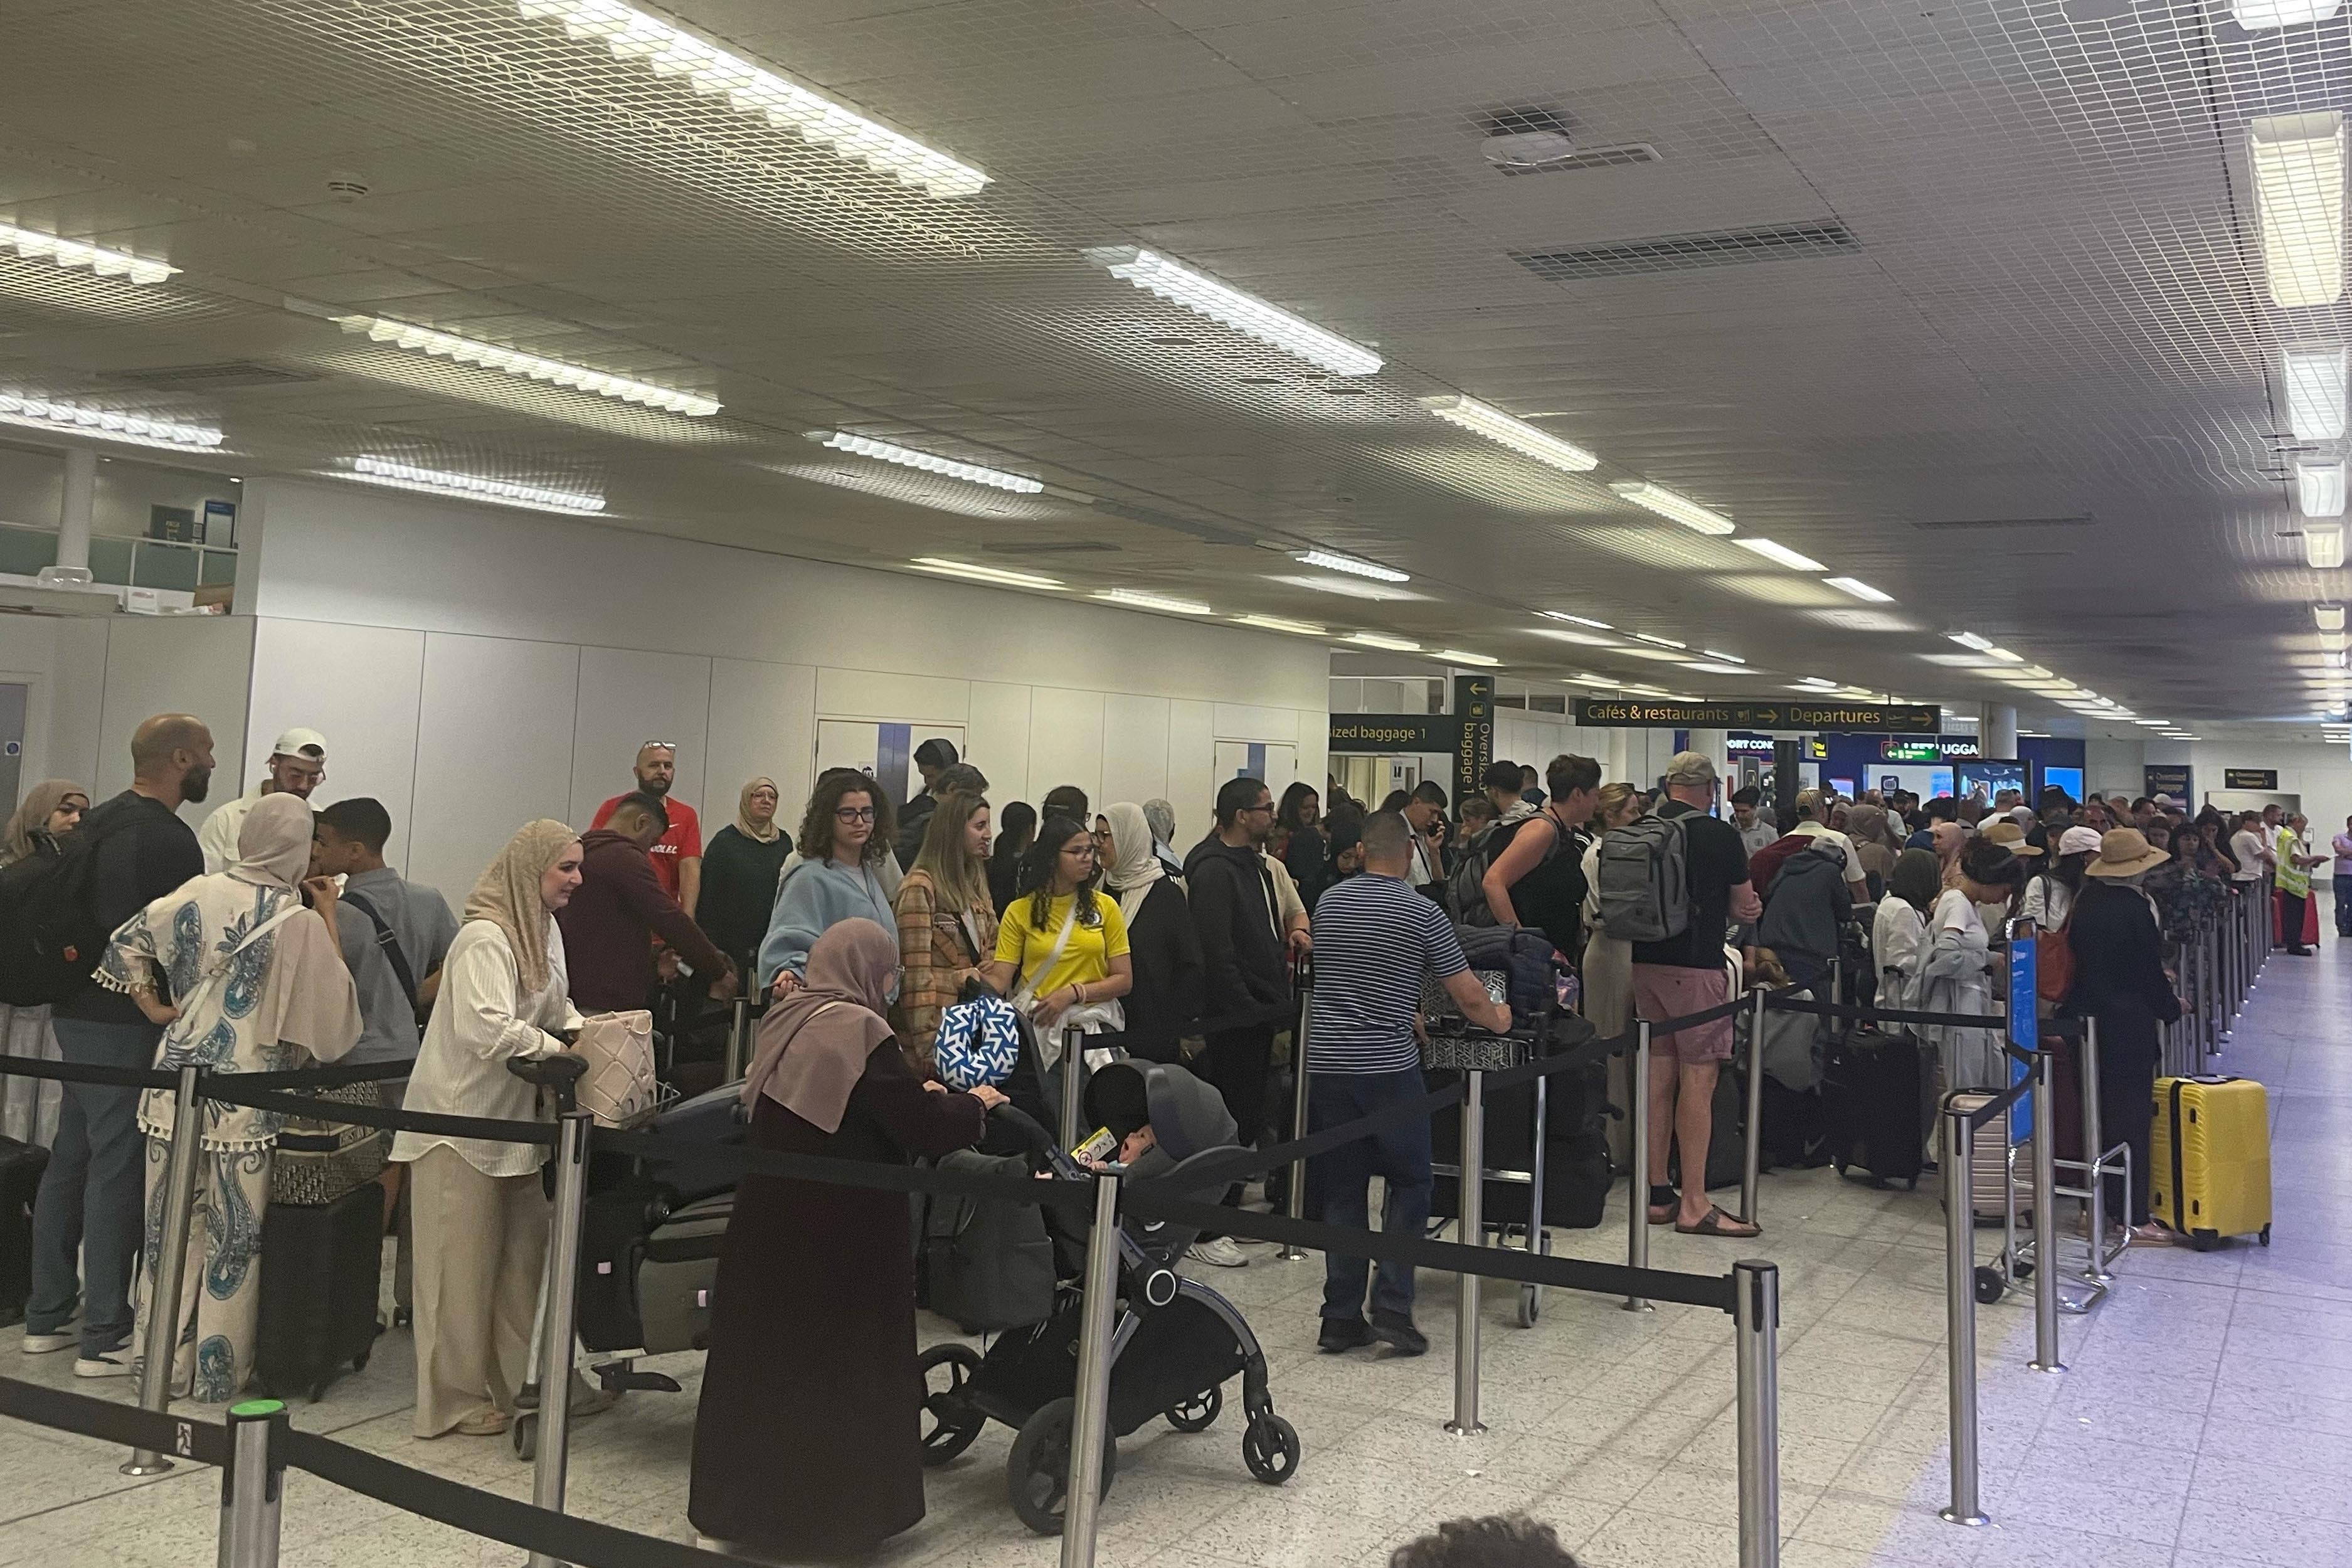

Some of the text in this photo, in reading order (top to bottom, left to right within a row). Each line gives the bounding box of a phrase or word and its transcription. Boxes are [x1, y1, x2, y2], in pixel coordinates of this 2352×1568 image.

[1587, 704, 1729, 721] Cafés & restaurants
[1790, 707, 1880, 726] Departures
[1360, 725, 1416, 742] baggage
[1421, 728, 1426, 739] 1
[1461, 722, 1478, 784] baggage
[1726, 739, 1749, 750] ORT
